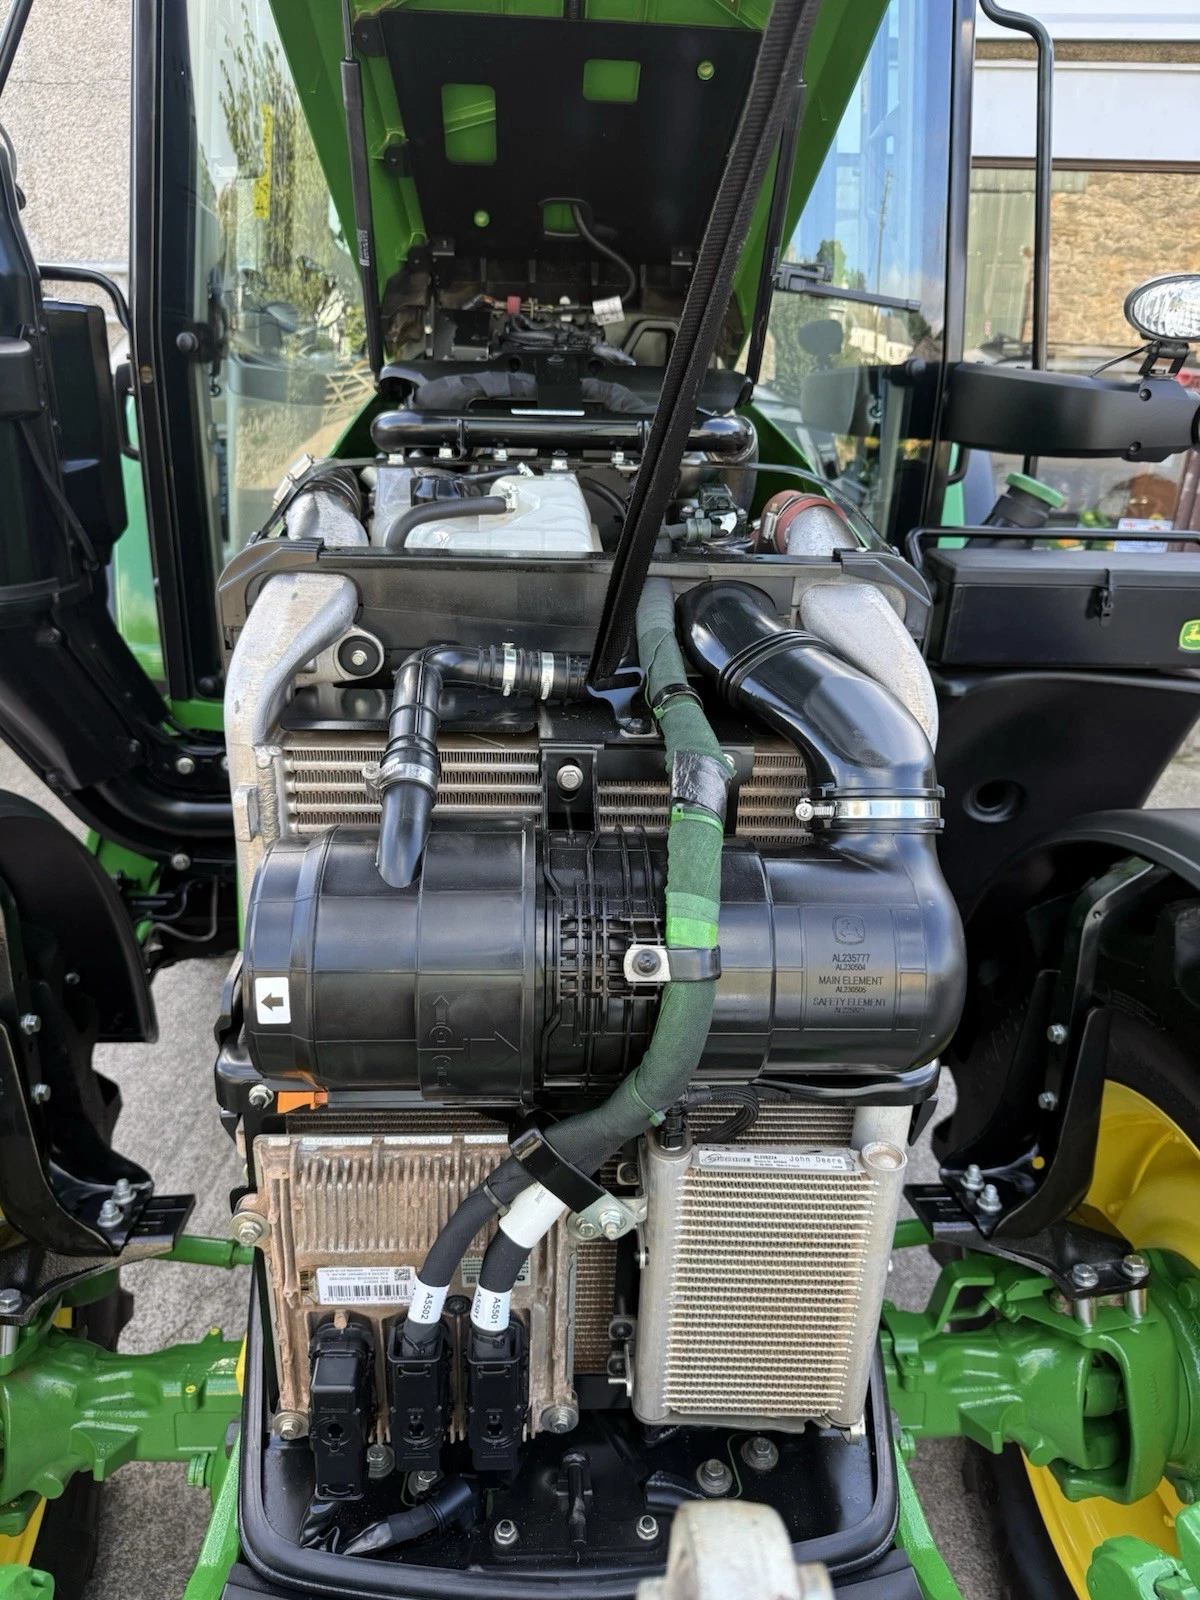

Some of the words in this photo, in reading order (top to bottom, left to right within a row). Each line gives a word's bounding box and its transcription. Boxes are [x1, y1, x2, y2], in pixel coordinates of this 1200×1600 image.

[832, 953, 870, 963] AL235777
[818, 975, 840, 985] MAIN
[842, 976, 884, 985] ELEMENT
[813, 997, 846, 1006] SAFETY
[847, 998, 886, 1007] ELEMENT
[789, 1156, 811, 1164] John
[815, 1156, 843, 1165] Deere
[420, 1292, 434, 1320] A5502
[473, 1289, 482, 1320] A5501
[490, 1297, 502, 1325] A5501
